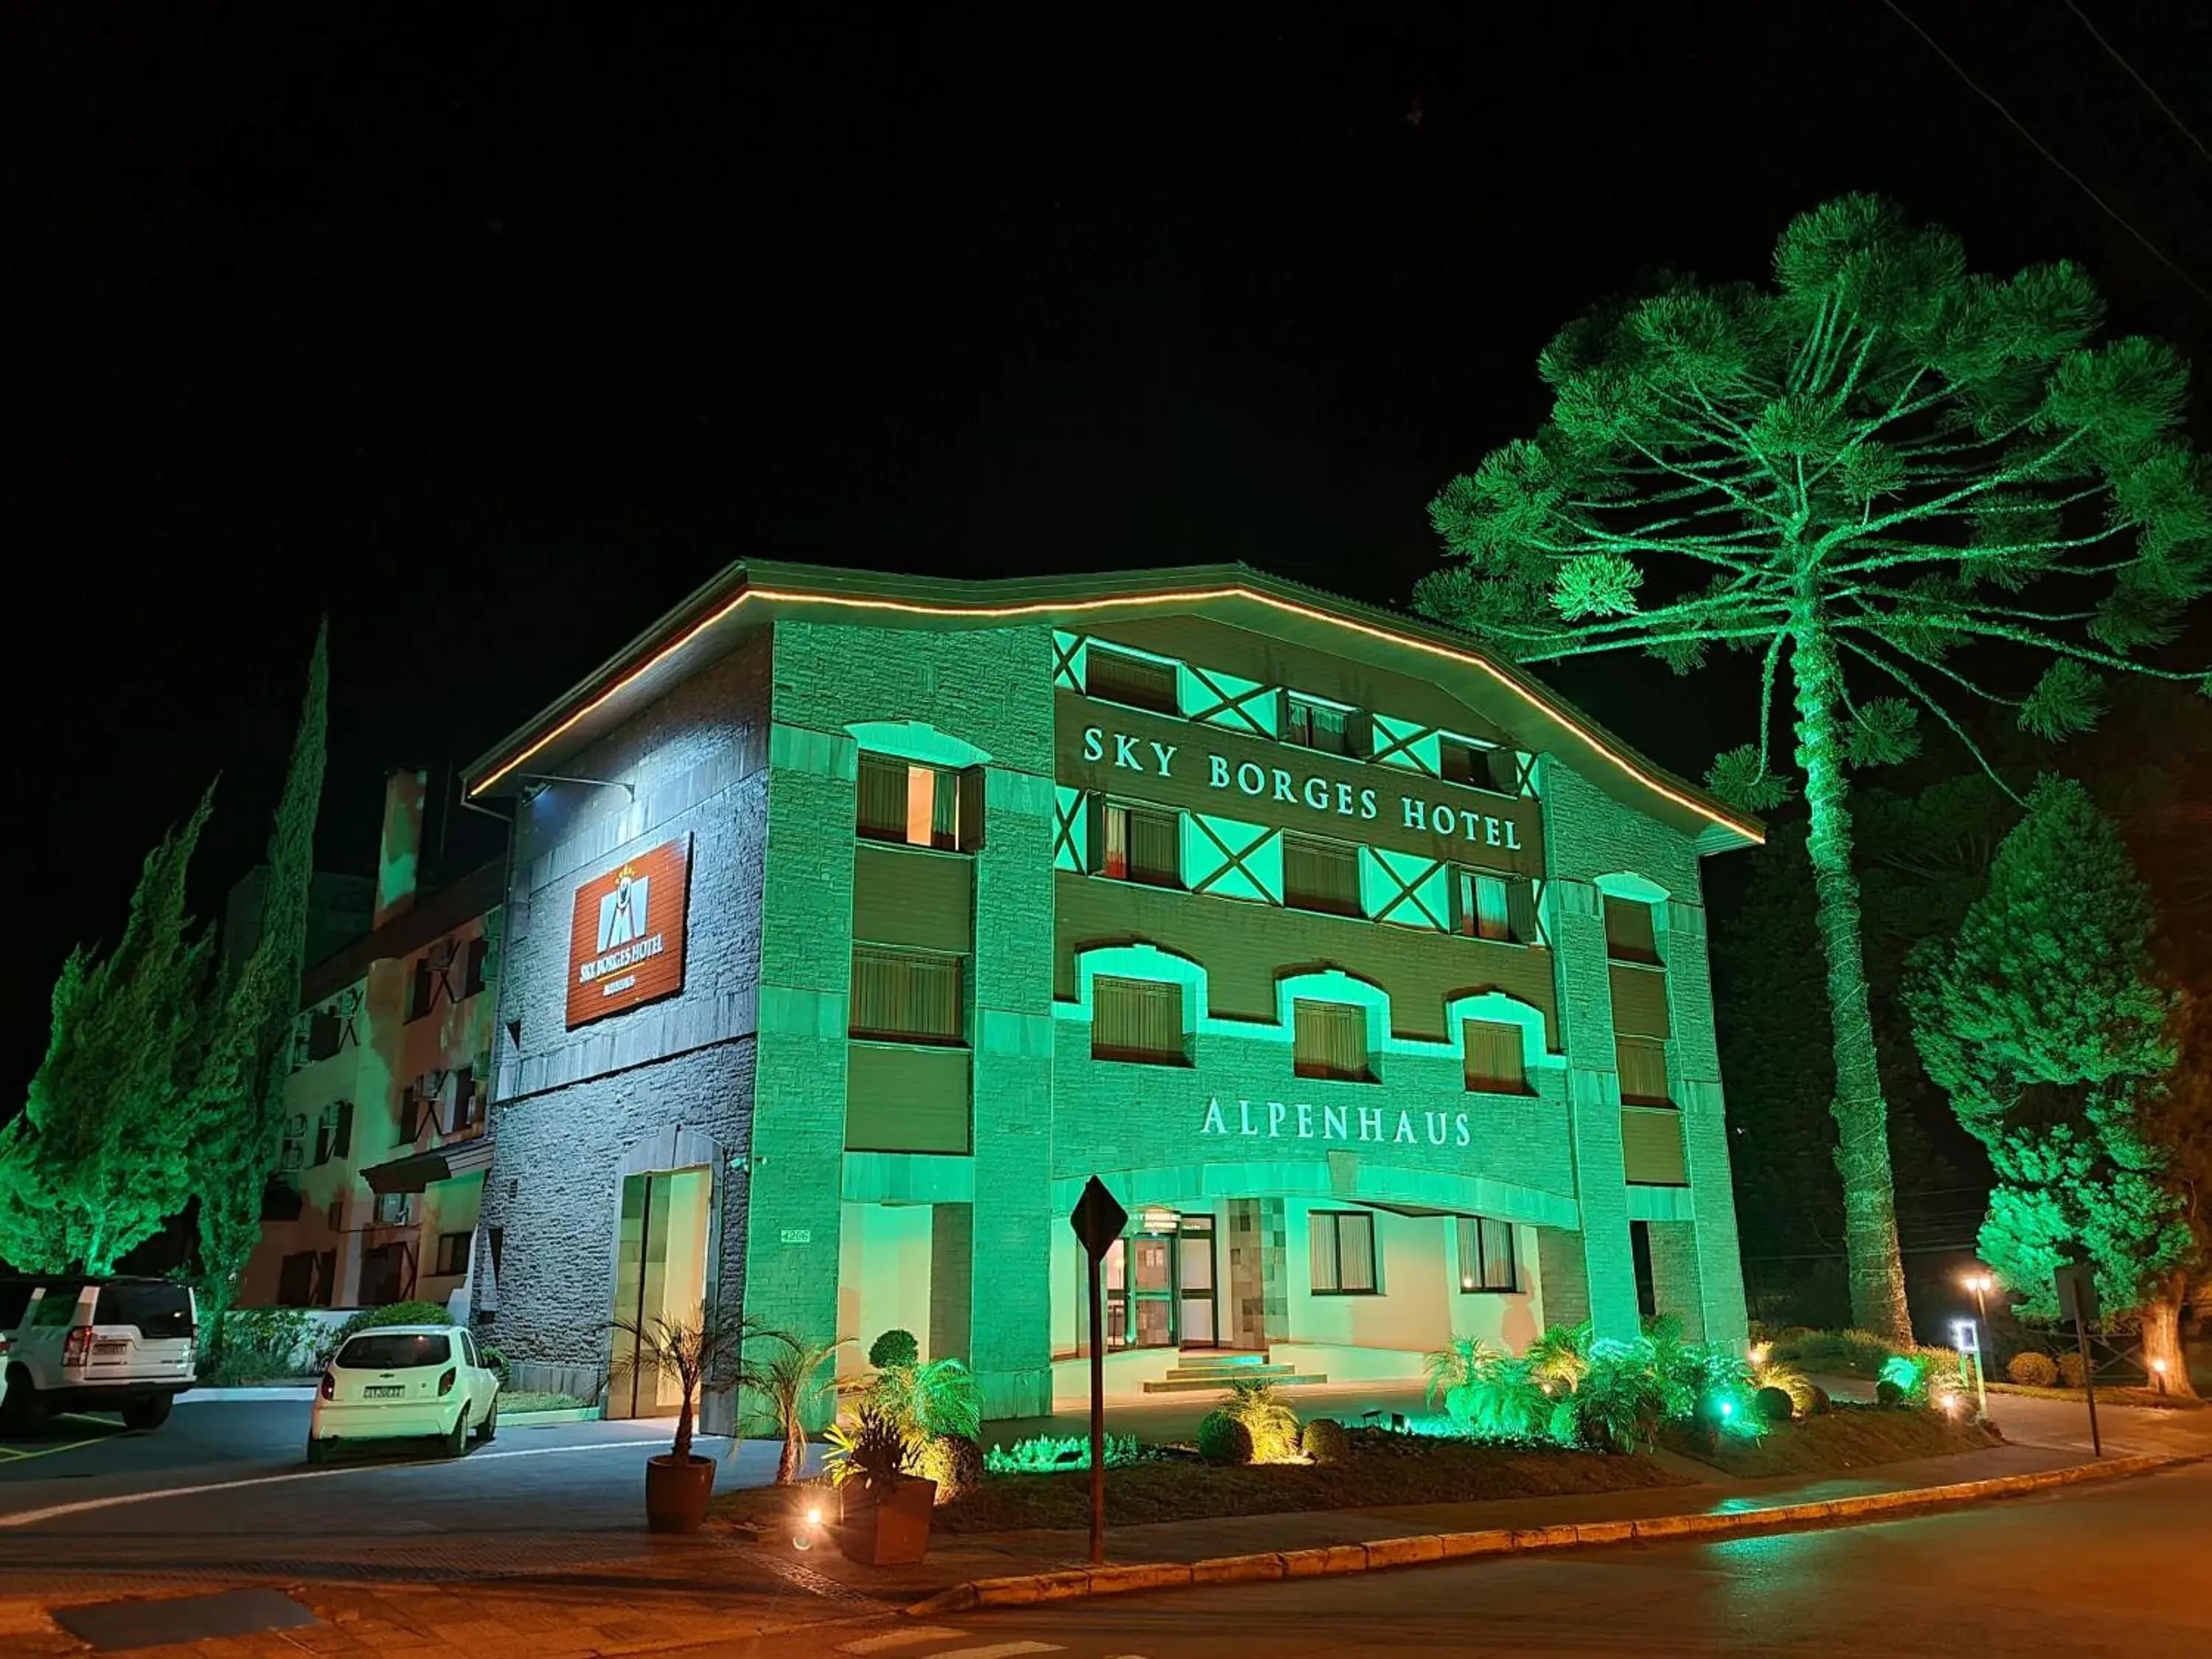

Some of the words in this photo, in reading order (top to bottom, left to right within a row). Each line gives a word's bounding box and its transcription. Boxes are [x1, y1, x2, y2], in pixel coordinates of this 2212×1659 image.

[1083, 727, 1178, 778] SKY
[1208, 754, 1377, 820] BORGES
[1401, 796, 1522, 851] HOTEL
[1200, 1096, 1471, 1147] ALPENHAUS
